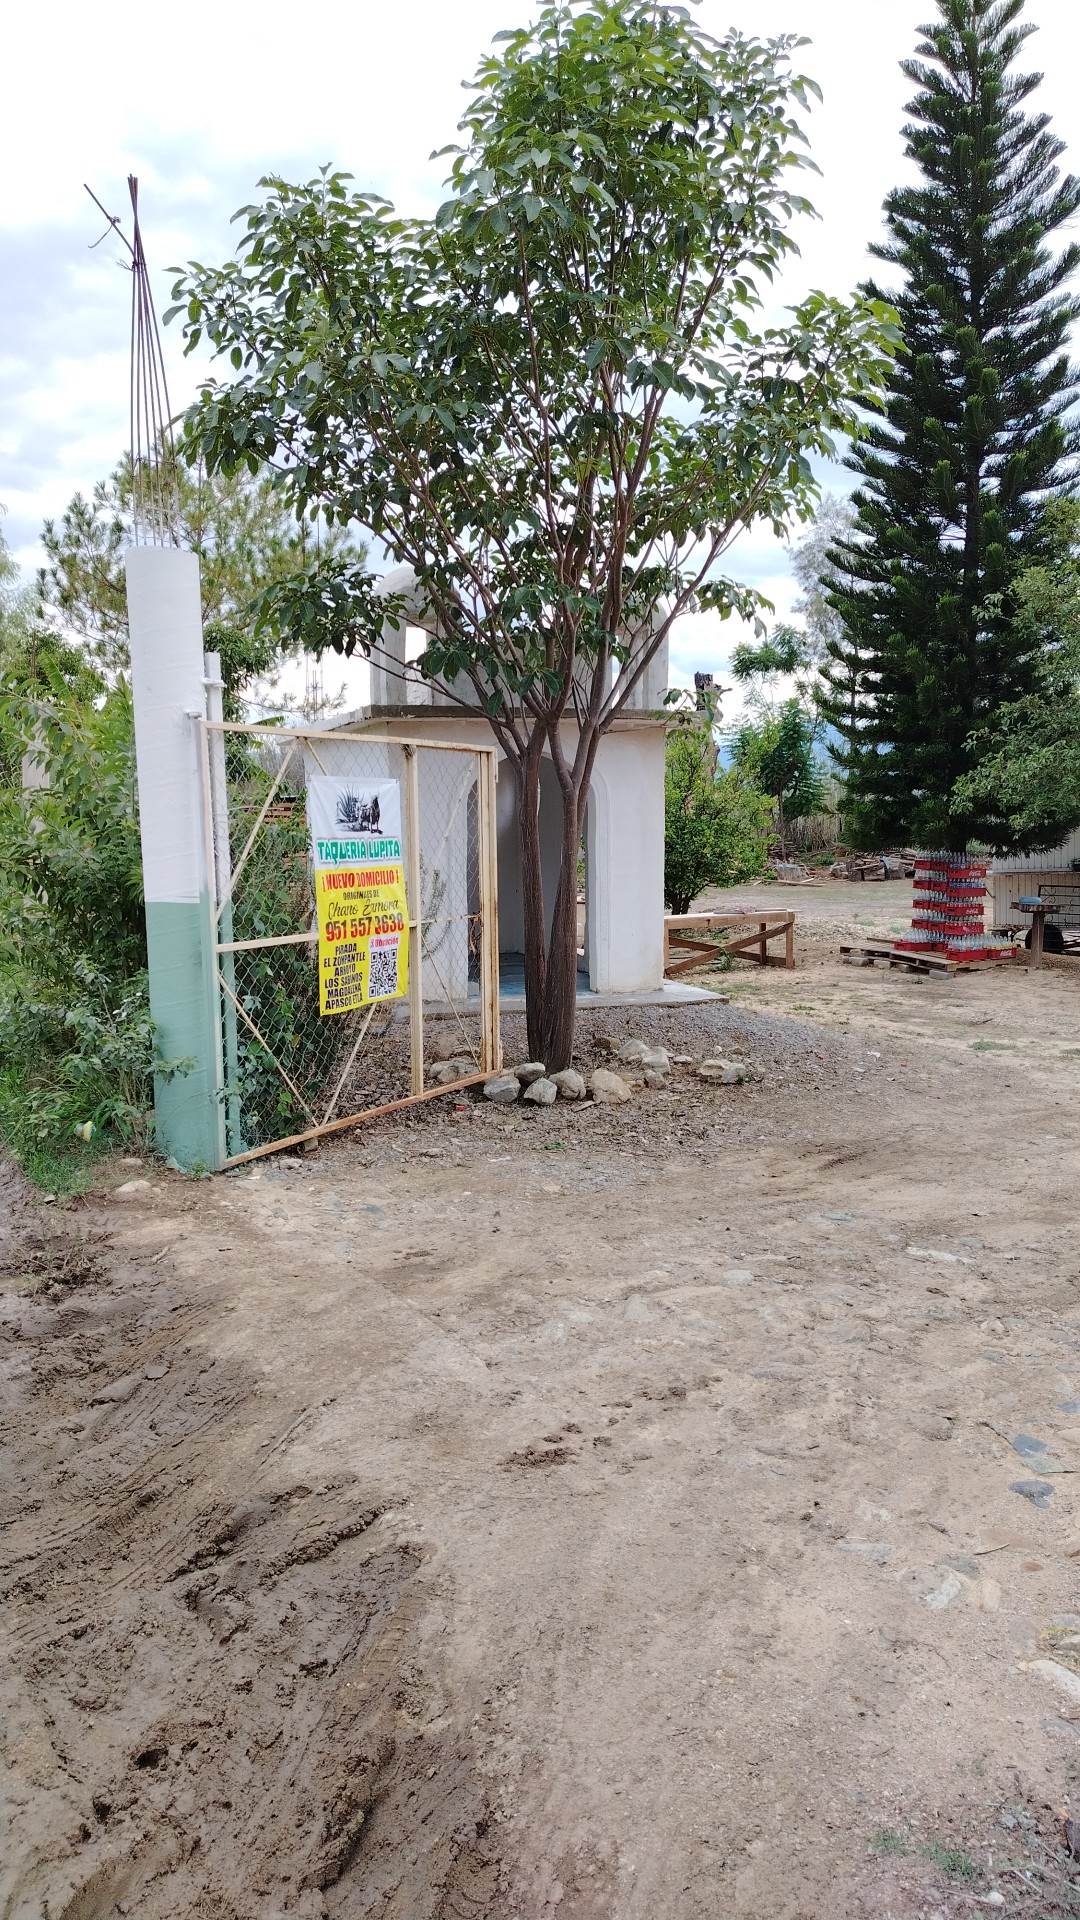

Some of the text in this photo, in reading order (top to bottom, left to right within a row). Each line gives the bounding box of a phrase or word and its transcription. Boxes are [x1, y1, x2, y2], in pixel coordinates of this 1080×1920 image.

[317, 840, 401, 865] TAQUERIA LUPITA
[328, 901, 358, 920] Chano
[325, 913, 404, 941] 951 557 3638
[335, 943, 357, 955] PARADA
[324, 958, 331, 967] EL
[334, 963, 356, 977] ARROYO
[325, 972, 363, 988] LOS SABINOS
[327, 983, 361, 999] MAGDALENA
[325, 993, 363, 1010] APASCO ETLA
